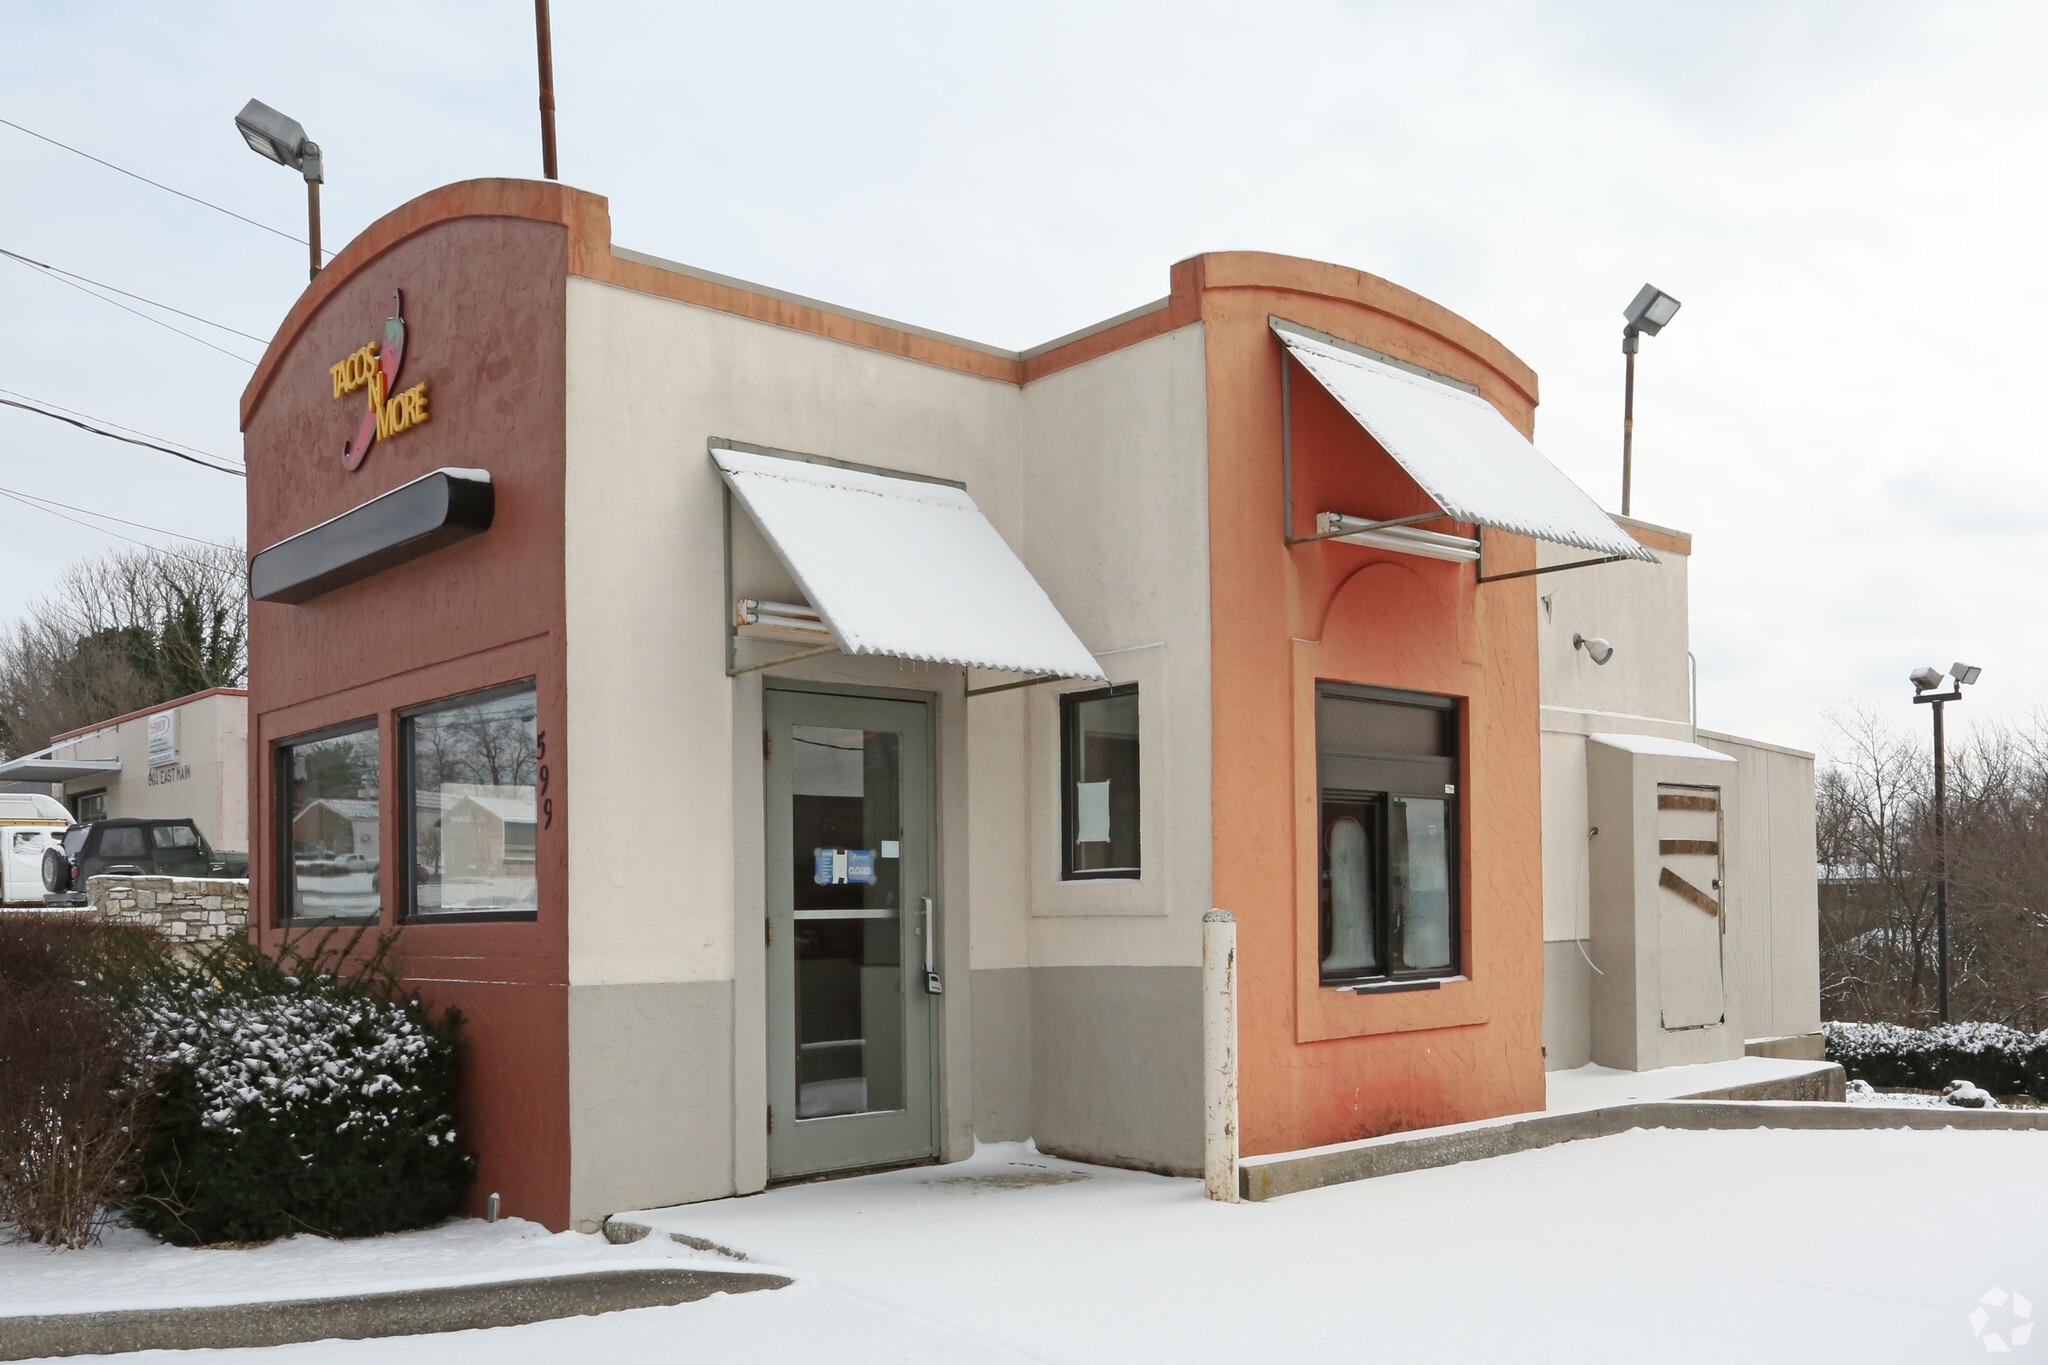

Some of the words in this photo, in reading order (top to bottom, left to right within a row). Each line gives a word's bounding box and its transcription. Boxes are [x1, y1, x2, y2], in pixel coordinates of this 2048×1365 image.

[330, 341, 379, 400] TACOS
[368, 371, 384, 413] N
[376, 381, 429, 442] MORE
[160, 767, 175, 785] EAST
[176, 763, 191, 782] MAIN
[536, 730, 552, 830] 599
[848, 866, 872, 876] CLOSED
